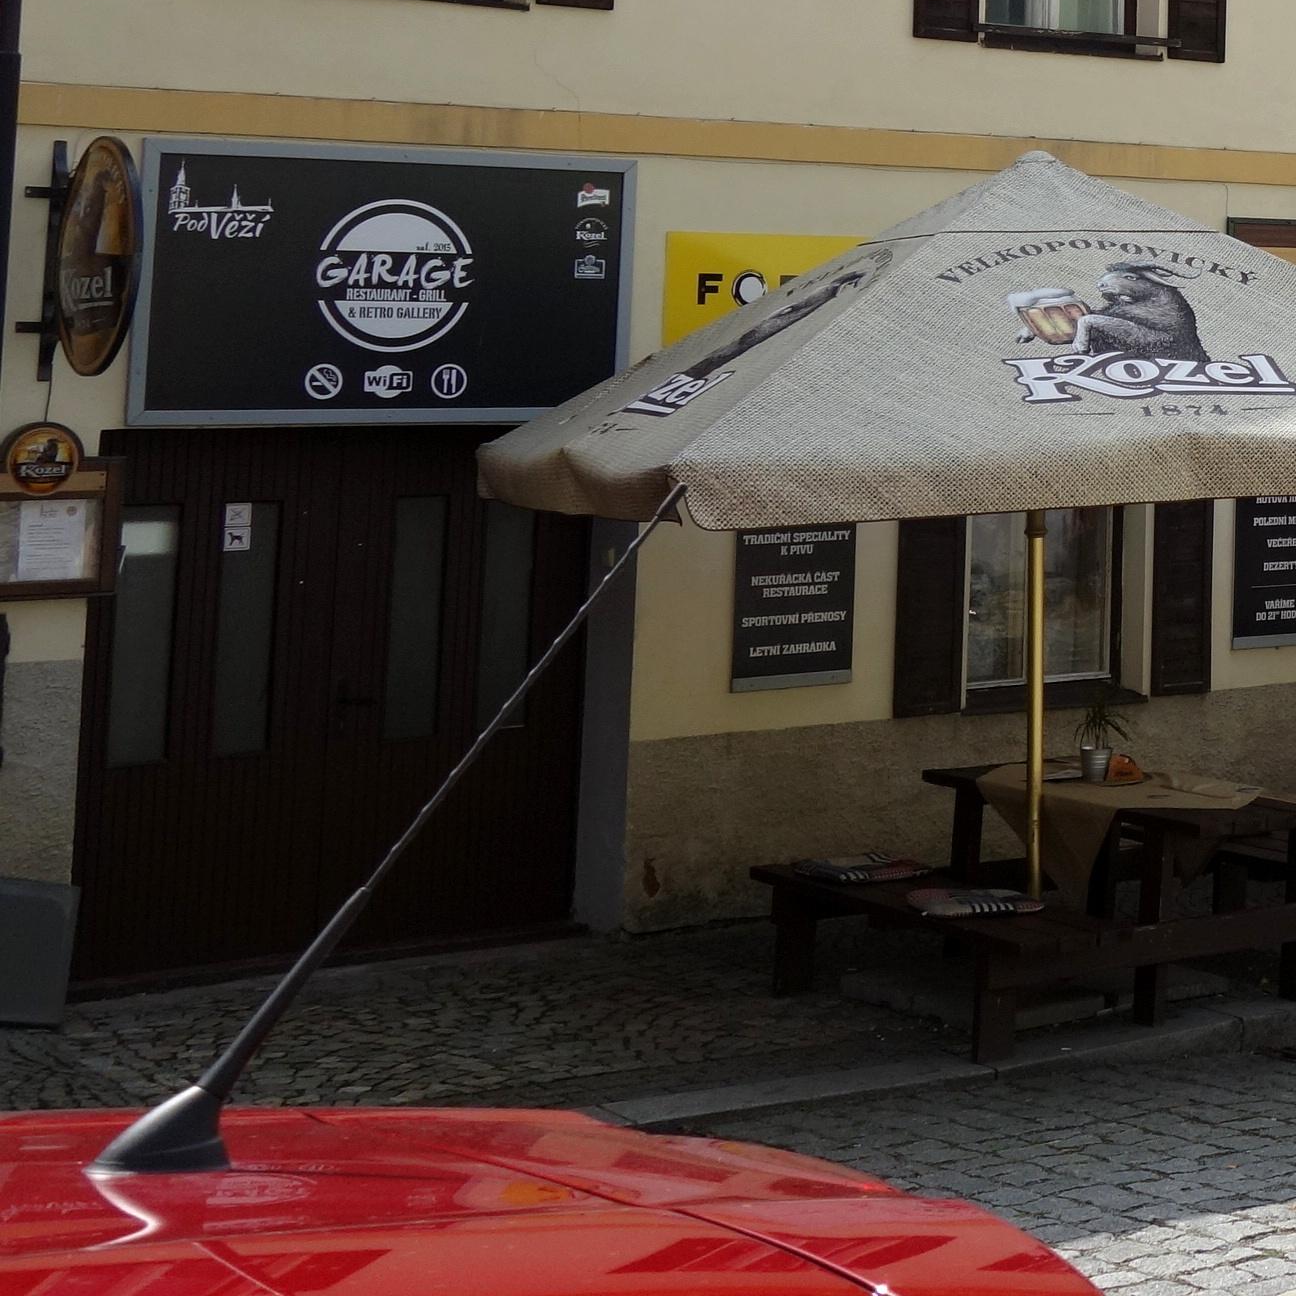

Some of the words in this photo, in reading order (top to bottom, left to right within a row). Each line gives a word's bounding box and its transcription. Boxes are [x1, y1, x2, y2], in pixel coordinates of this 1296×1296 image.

[173, 213, 209, 232] Pod
[210, 212, 271, 239] Věží
[935, 238, 1260, 286] VELKOPOPOVICKÝ
[316, 252, 475, 289] GARAGE
[60, 266, 114, 317] Kozel
[346, 288, 411, 301] RESTAURANT
[418, 289, 446, 302] GRILL
[359, 307, 394, 318] RETRO
[396, 307, 442, 319] GALLERY
[1142, 404, 1229, 417] 1874
[20, 464, 66, 477] Kozel
[1253, 515, 1287, 526] POLEDNÍ
[743, 532, 792, 545] TRADIČNÍ
[792, 530, 851, 543] SPECIALITY
[780, 546, 788, 556] K
[790, 544, 814, 555] PIVU
[762, 584, 829, 598] RESTAURACE
[1265, 598, 1295, 609] VAŘÍME
[741, 612, 799, 628] SPORTOVNÍ
[1256, 612, 1267, 621] DO
